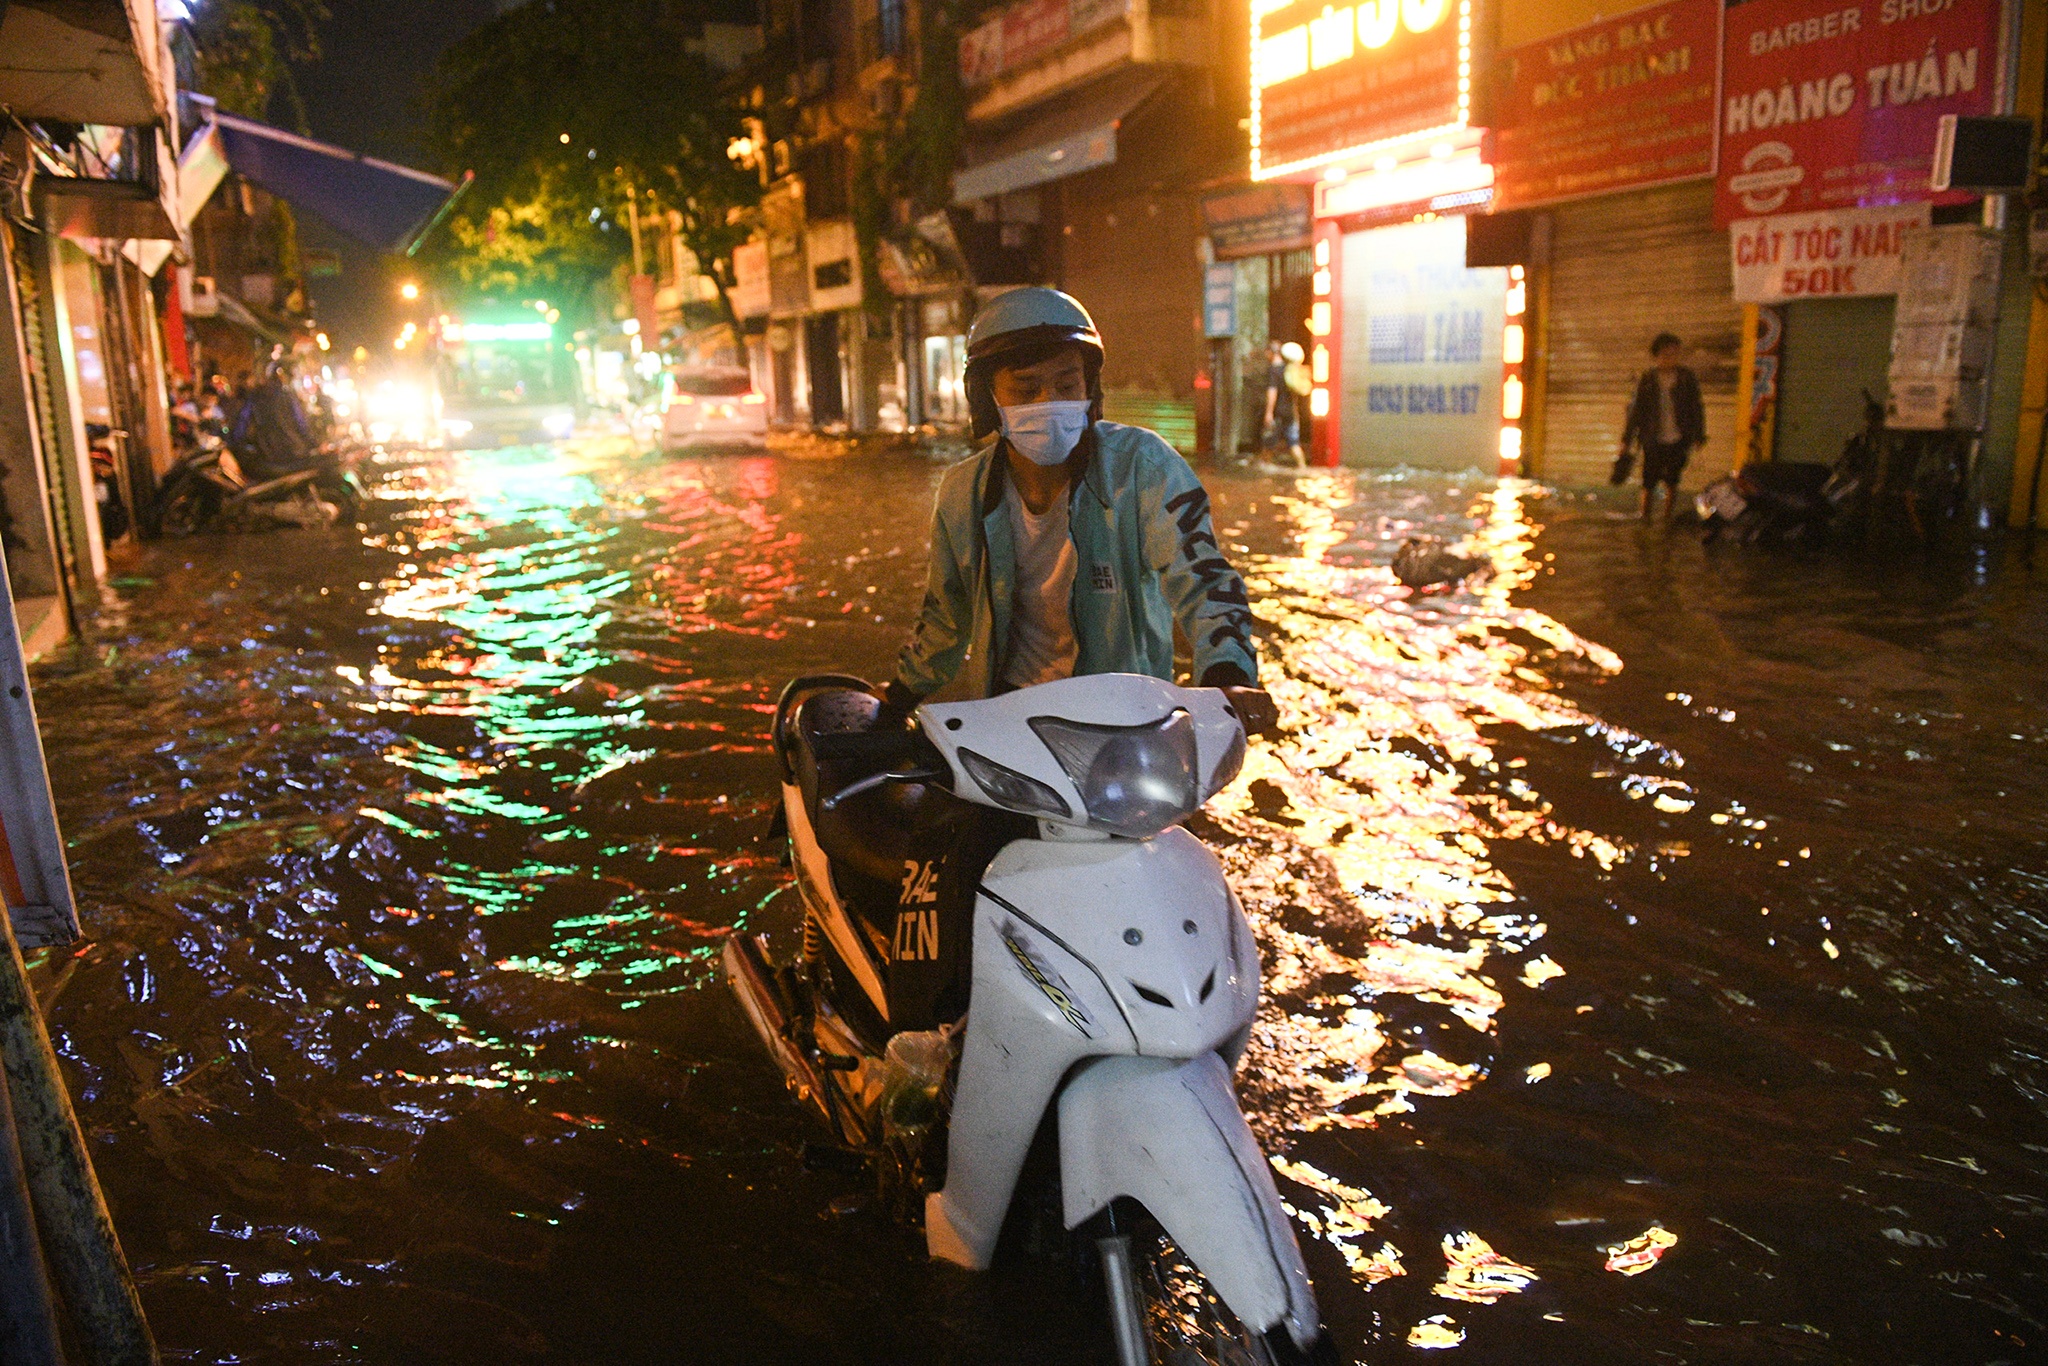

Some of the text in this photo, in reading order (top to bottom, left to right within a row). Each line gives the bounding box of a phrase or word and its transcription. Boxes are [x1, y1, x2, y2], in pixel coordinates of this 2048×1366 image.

[1750, 7, 1861, 55] BARBER
[1727, 73, 1855, 135] HOÀNG
[1866, 37, 1979, 109] TUẤN
[1793, 224, 1841, 261] TÓC
[1784, 265, 1856, 294] 50K
